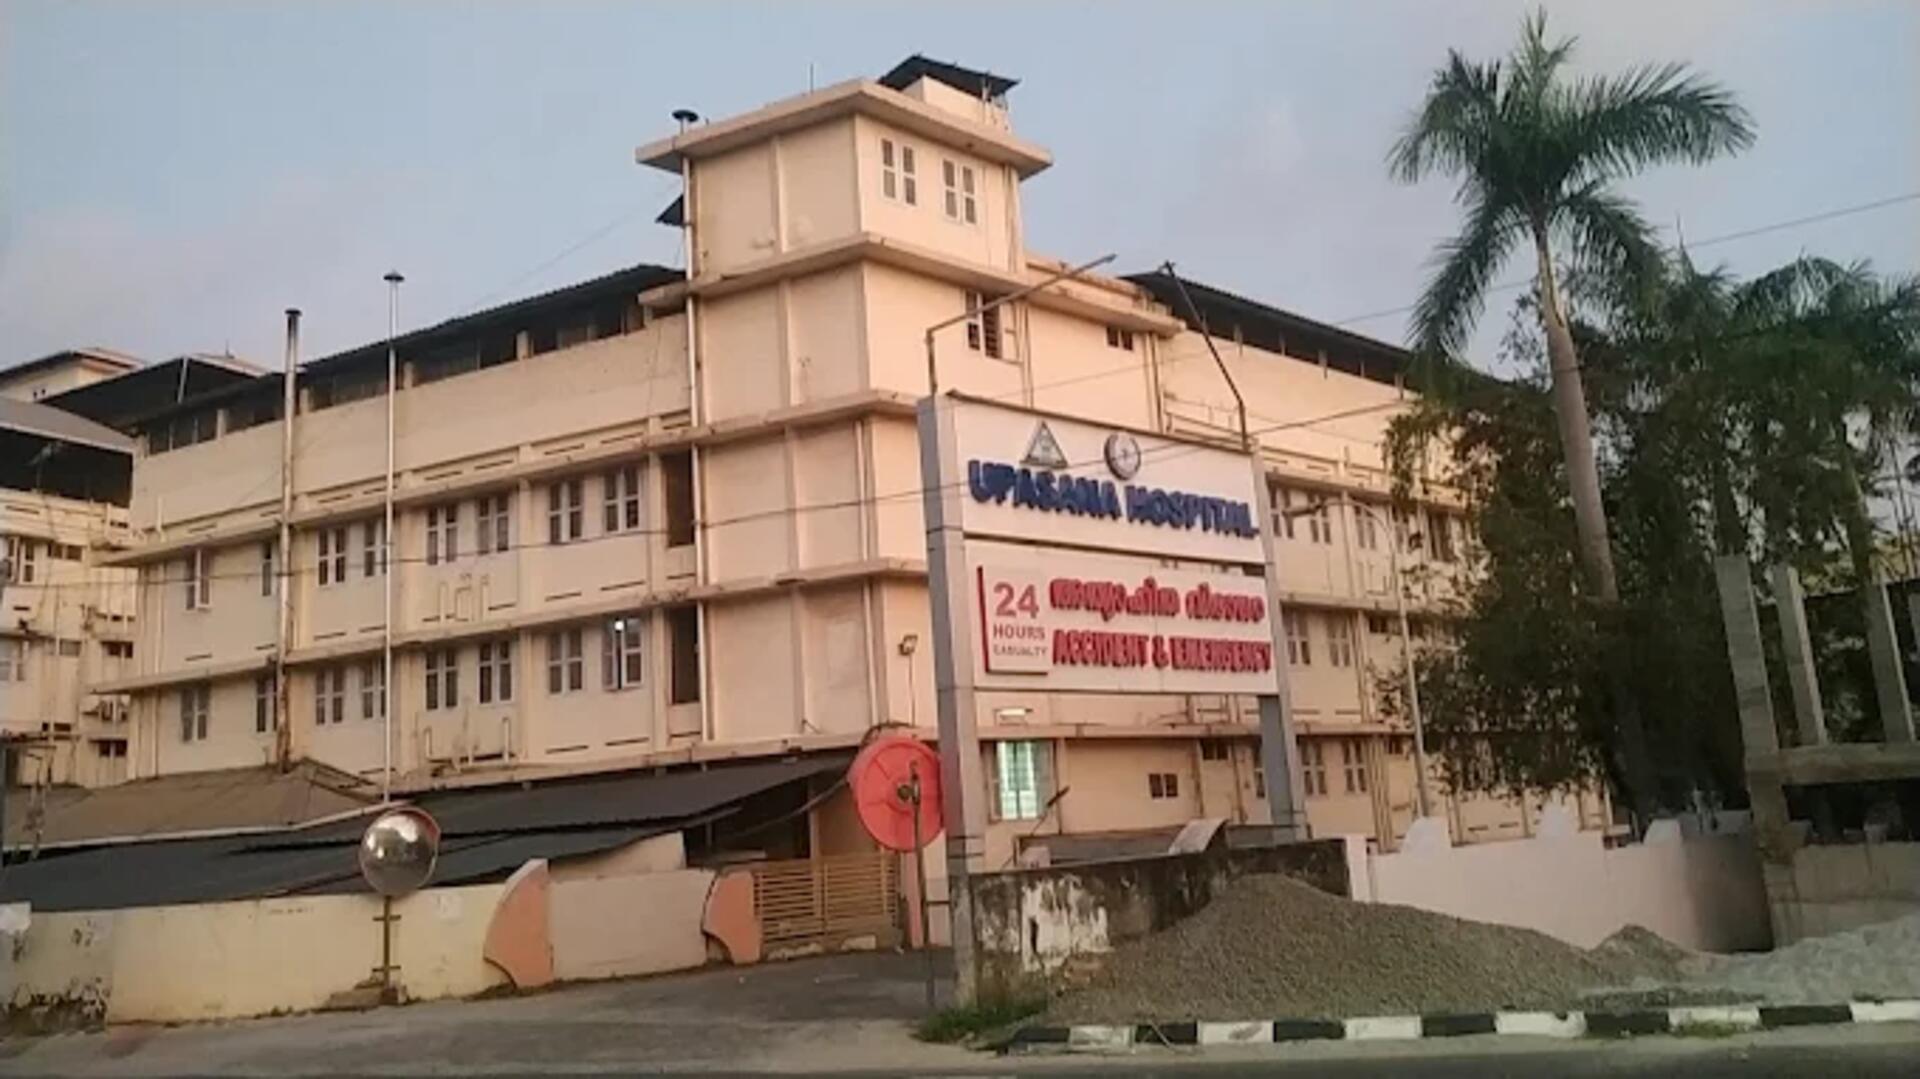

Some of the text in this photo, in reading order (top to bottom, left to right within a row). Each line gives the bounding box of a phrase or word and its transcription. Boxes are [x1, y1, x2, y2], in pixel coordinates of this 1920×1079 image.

[968, 459, 1259, 539] UPASANA HOSPITAL
[993, 582, 1039, 619] 24
[993, 623, 1045, 640] HOURS
[993, 644, 1047, 657] CASUALTY
[1052, 629, 1272, 673] ACCIDENT & EMERGENCY
